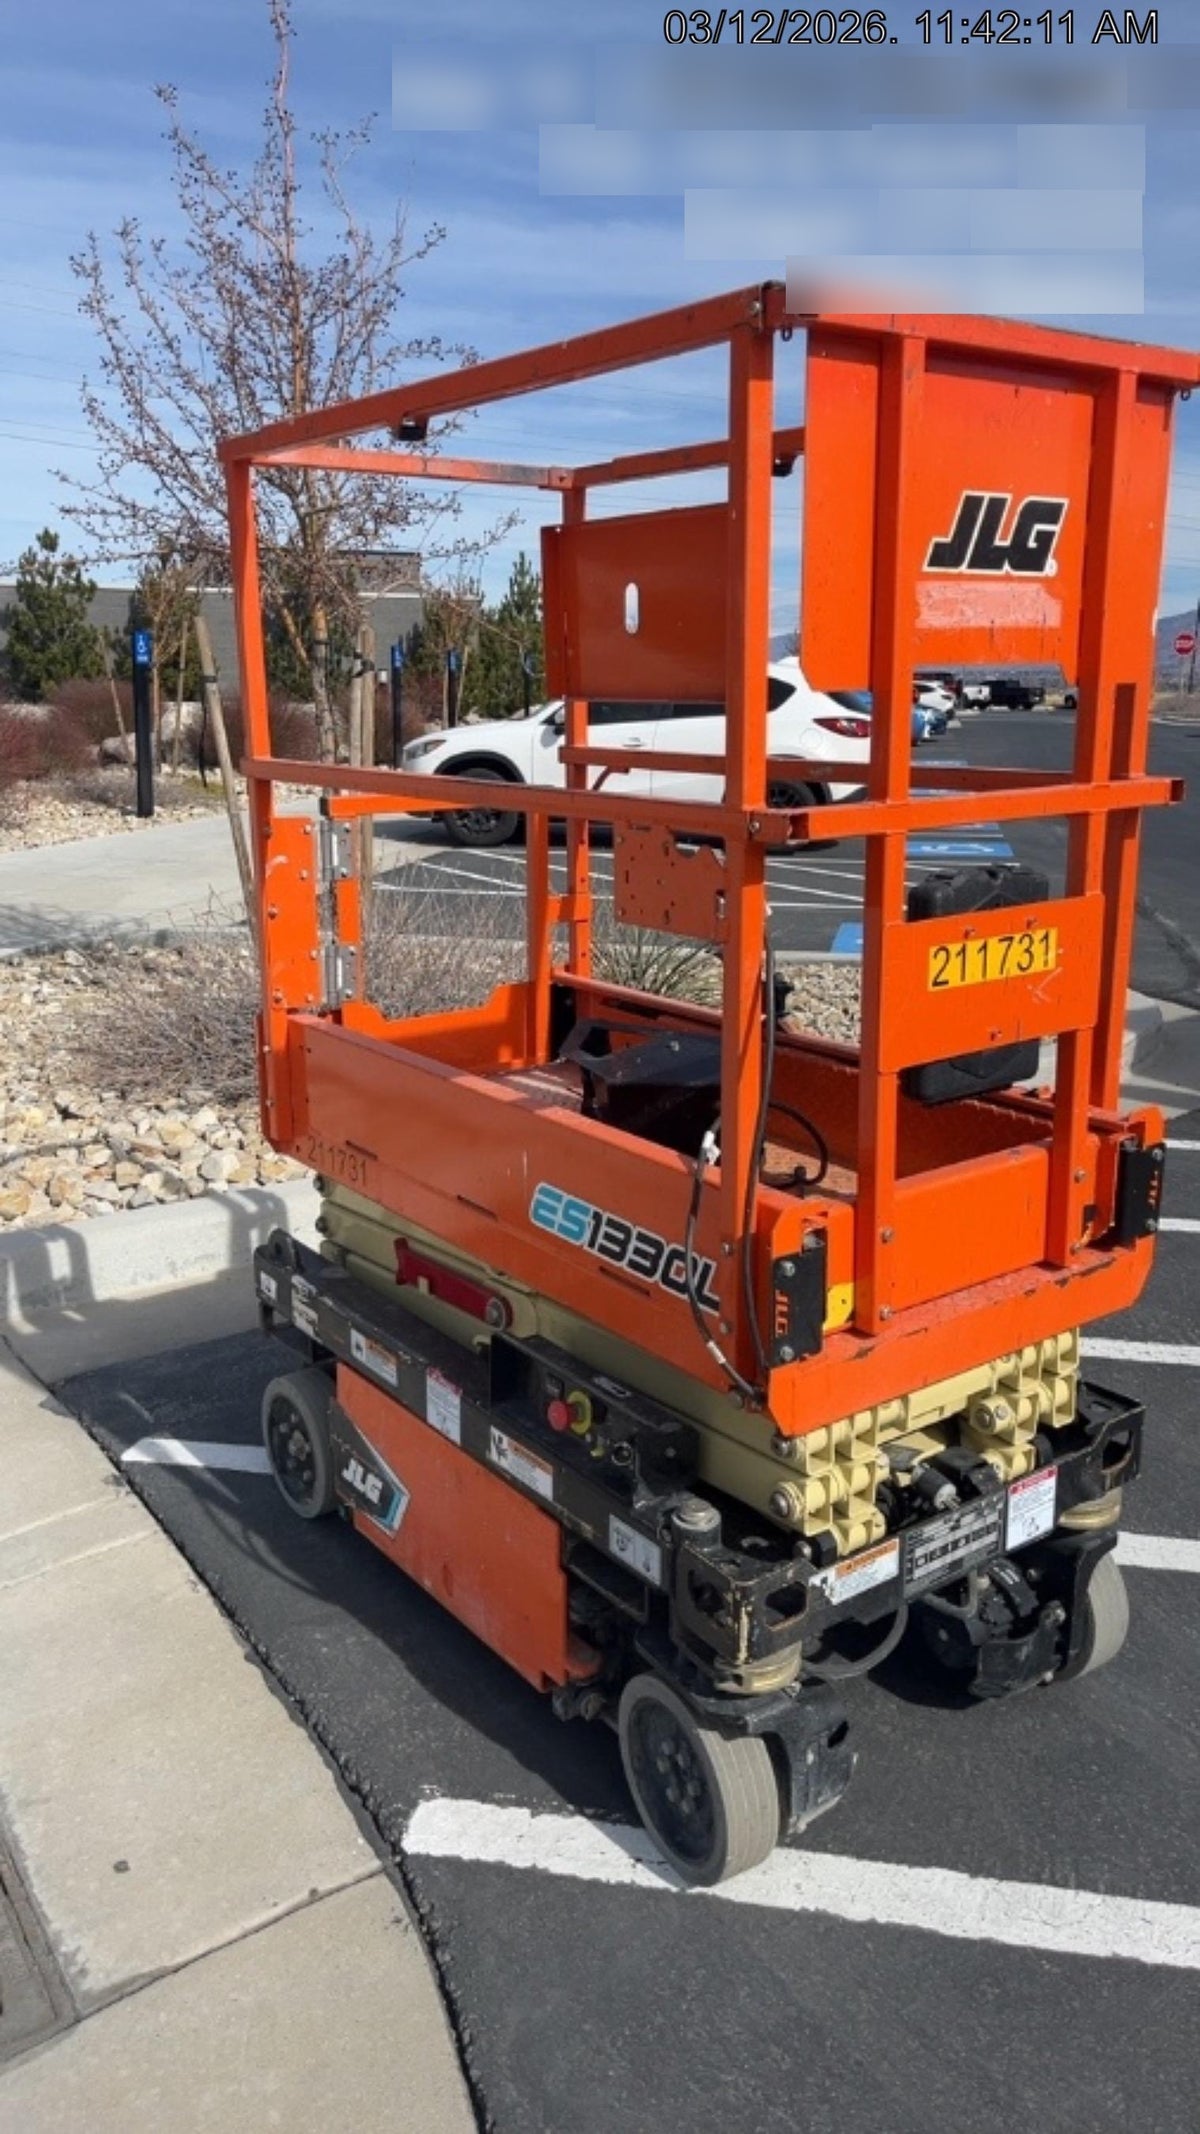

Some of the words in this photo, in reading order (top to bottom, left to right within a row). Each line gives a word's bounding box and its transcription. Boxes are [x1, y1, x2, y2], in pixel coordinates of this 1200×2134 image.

[923, 490, 1068, 576] JLG
[931, 929, 1053, 988] 211731
[307, 1135, 366, 1187] 211731
[530, 1182, 721, 1316] ES1330L
[775, 1289, 788, 1338] JLG
[341, 1458, 383, 1504] JLG
